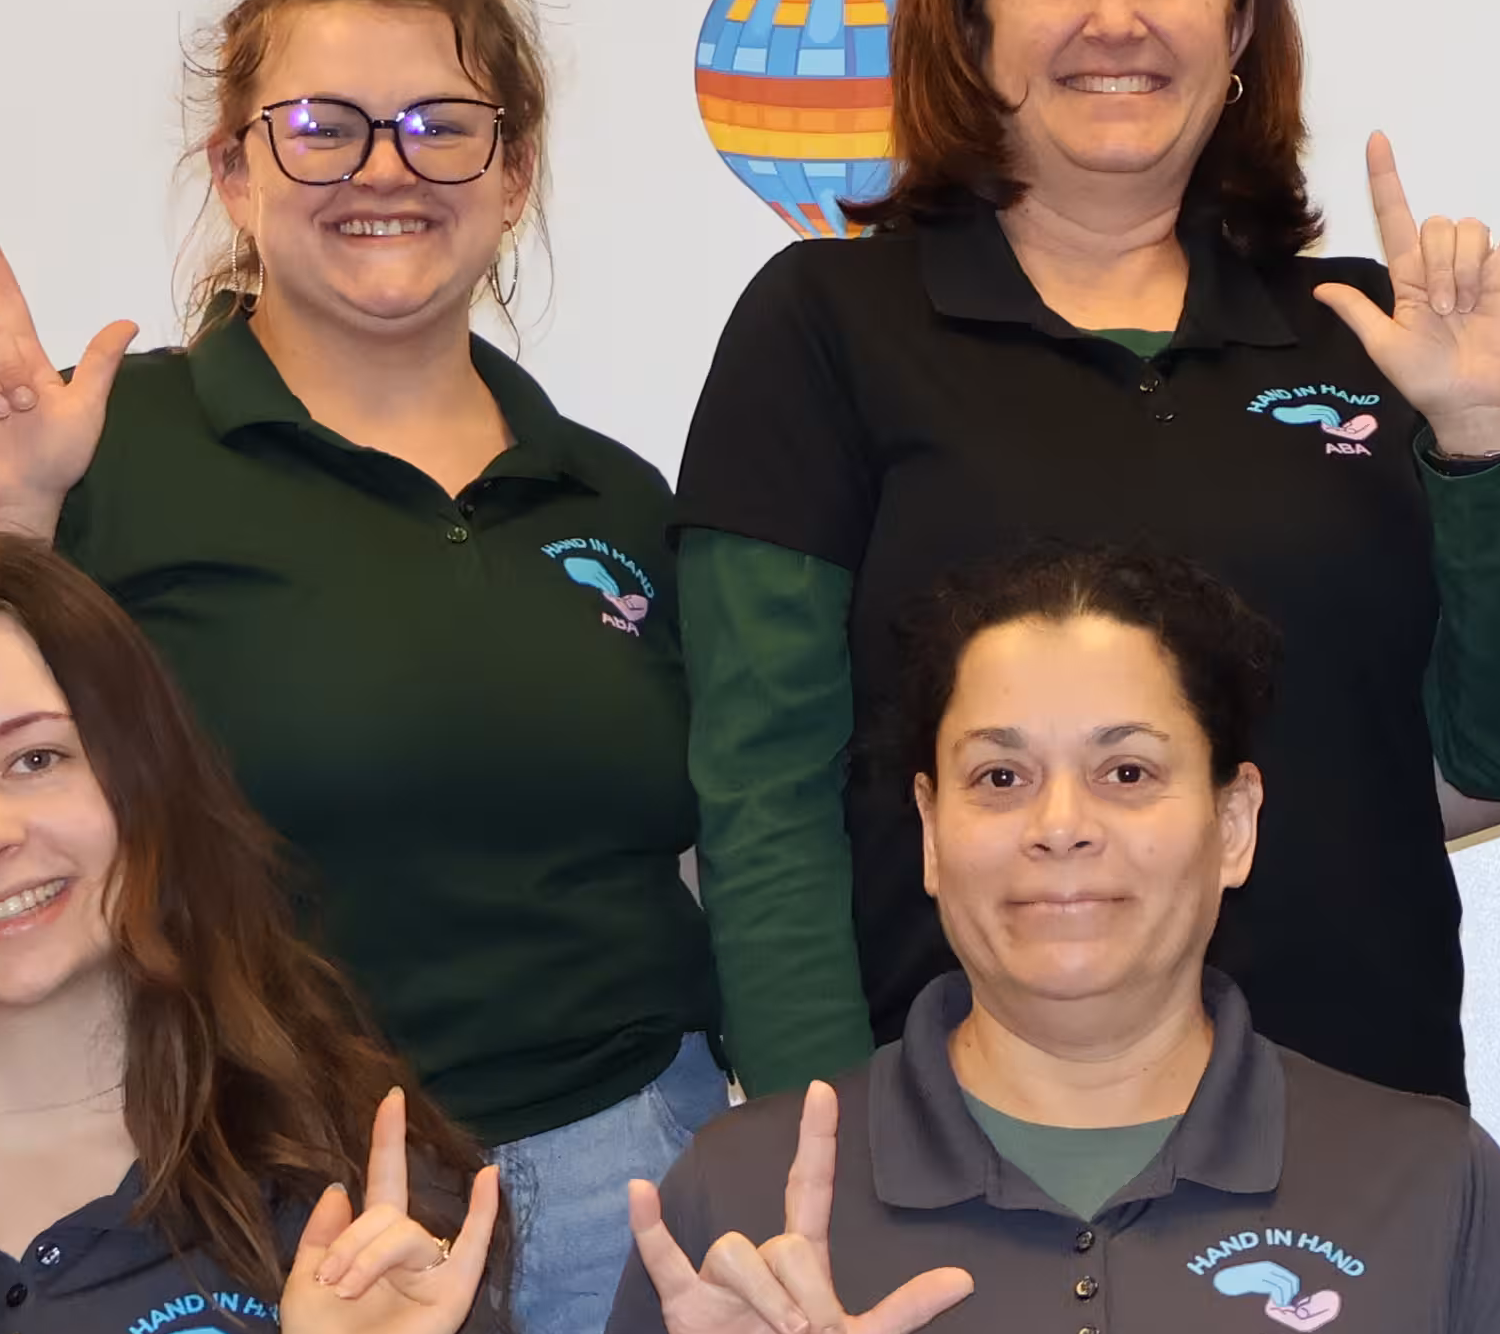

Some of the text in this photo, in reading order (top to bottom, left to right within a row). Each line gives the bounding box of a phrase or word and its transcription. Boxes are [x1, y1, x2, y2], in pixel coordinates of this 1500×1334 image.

[1247, 384, 1381, 413] HAND IN HAND
[1325, 442, 1372, 456] ABA
[541, 538, 655, 599] HAND IN HAND
[1187, 1229, 1365, 1276] HAND IN HAND
[212, 1292, 239, 1312] IN
